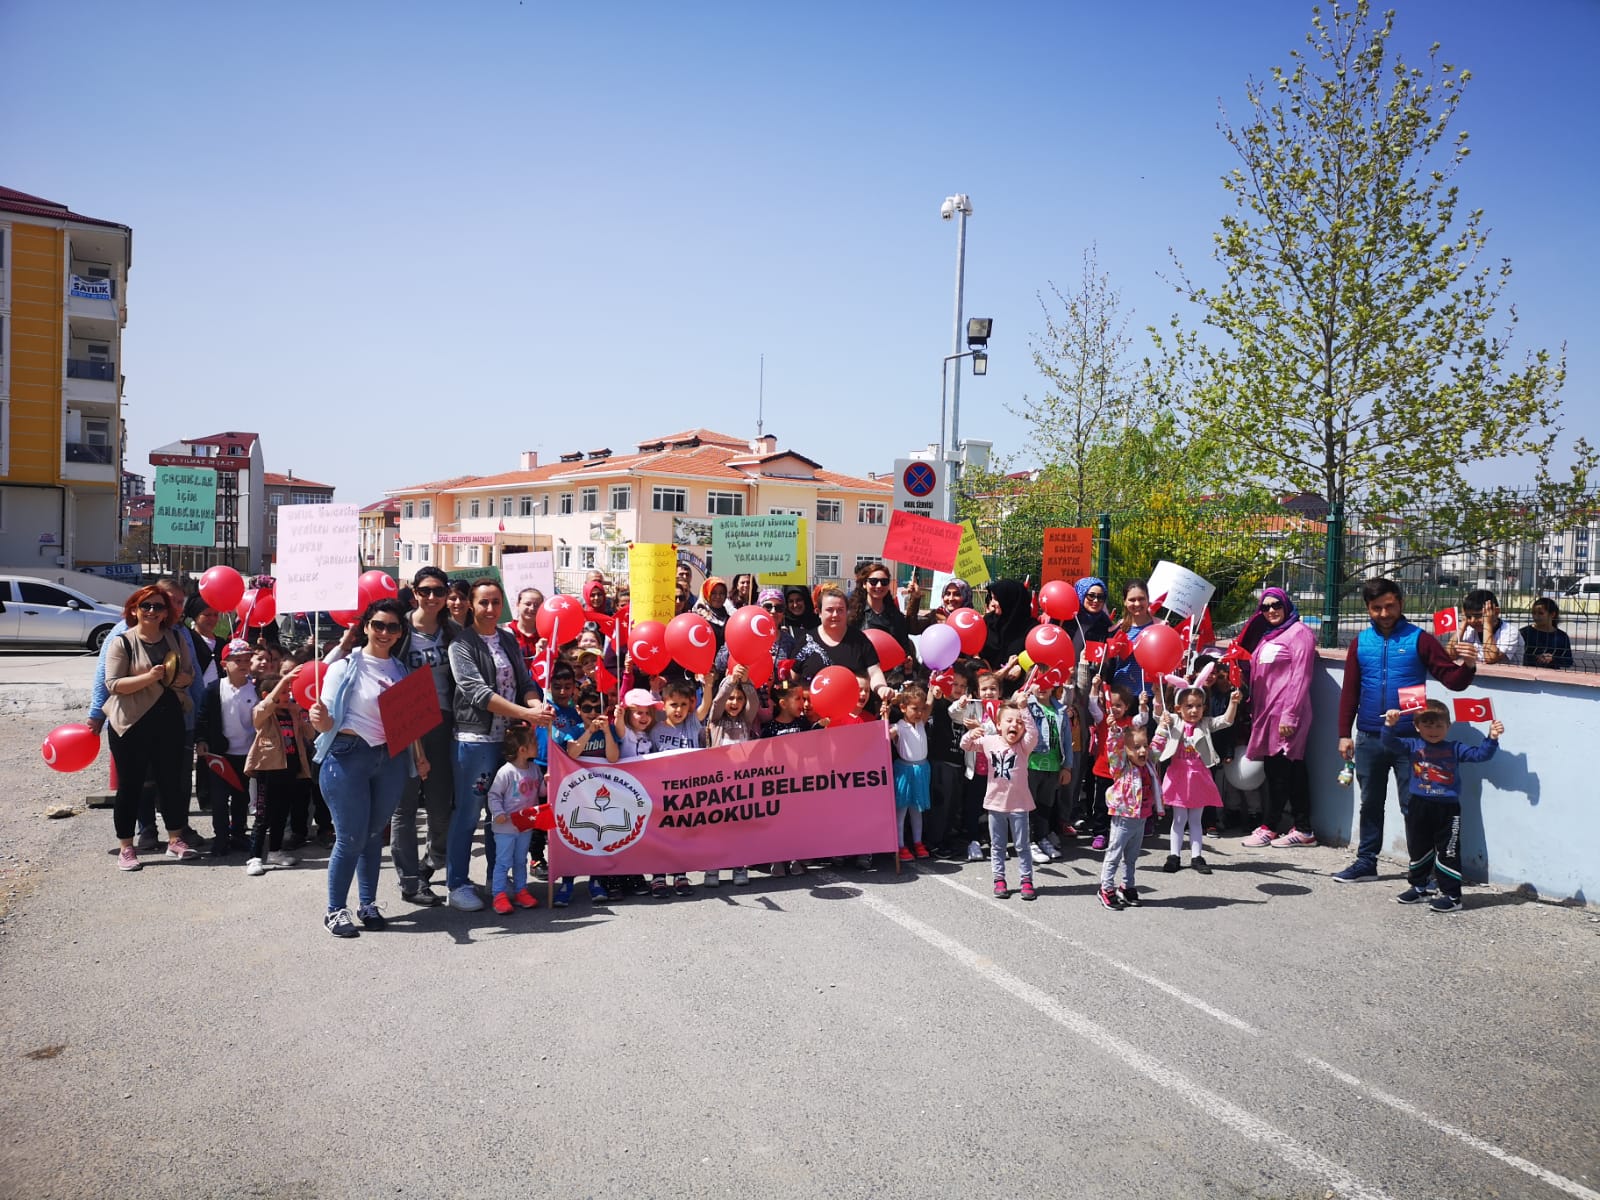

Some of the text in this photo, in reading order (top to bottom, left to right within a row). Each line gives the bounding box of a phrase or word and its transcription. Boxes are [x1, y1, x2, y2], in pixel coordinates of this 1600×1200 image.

[73, 282, 109, 294] SATILIK
[661, 769, 724, 791] TEKİRDAĞ
[733, 765, 785, 780] KAPAKLI
[662, 766, 888, 812] KAPAKLI BELEDİYESİ
[658, 799, 781, 829] ANAOKULU
